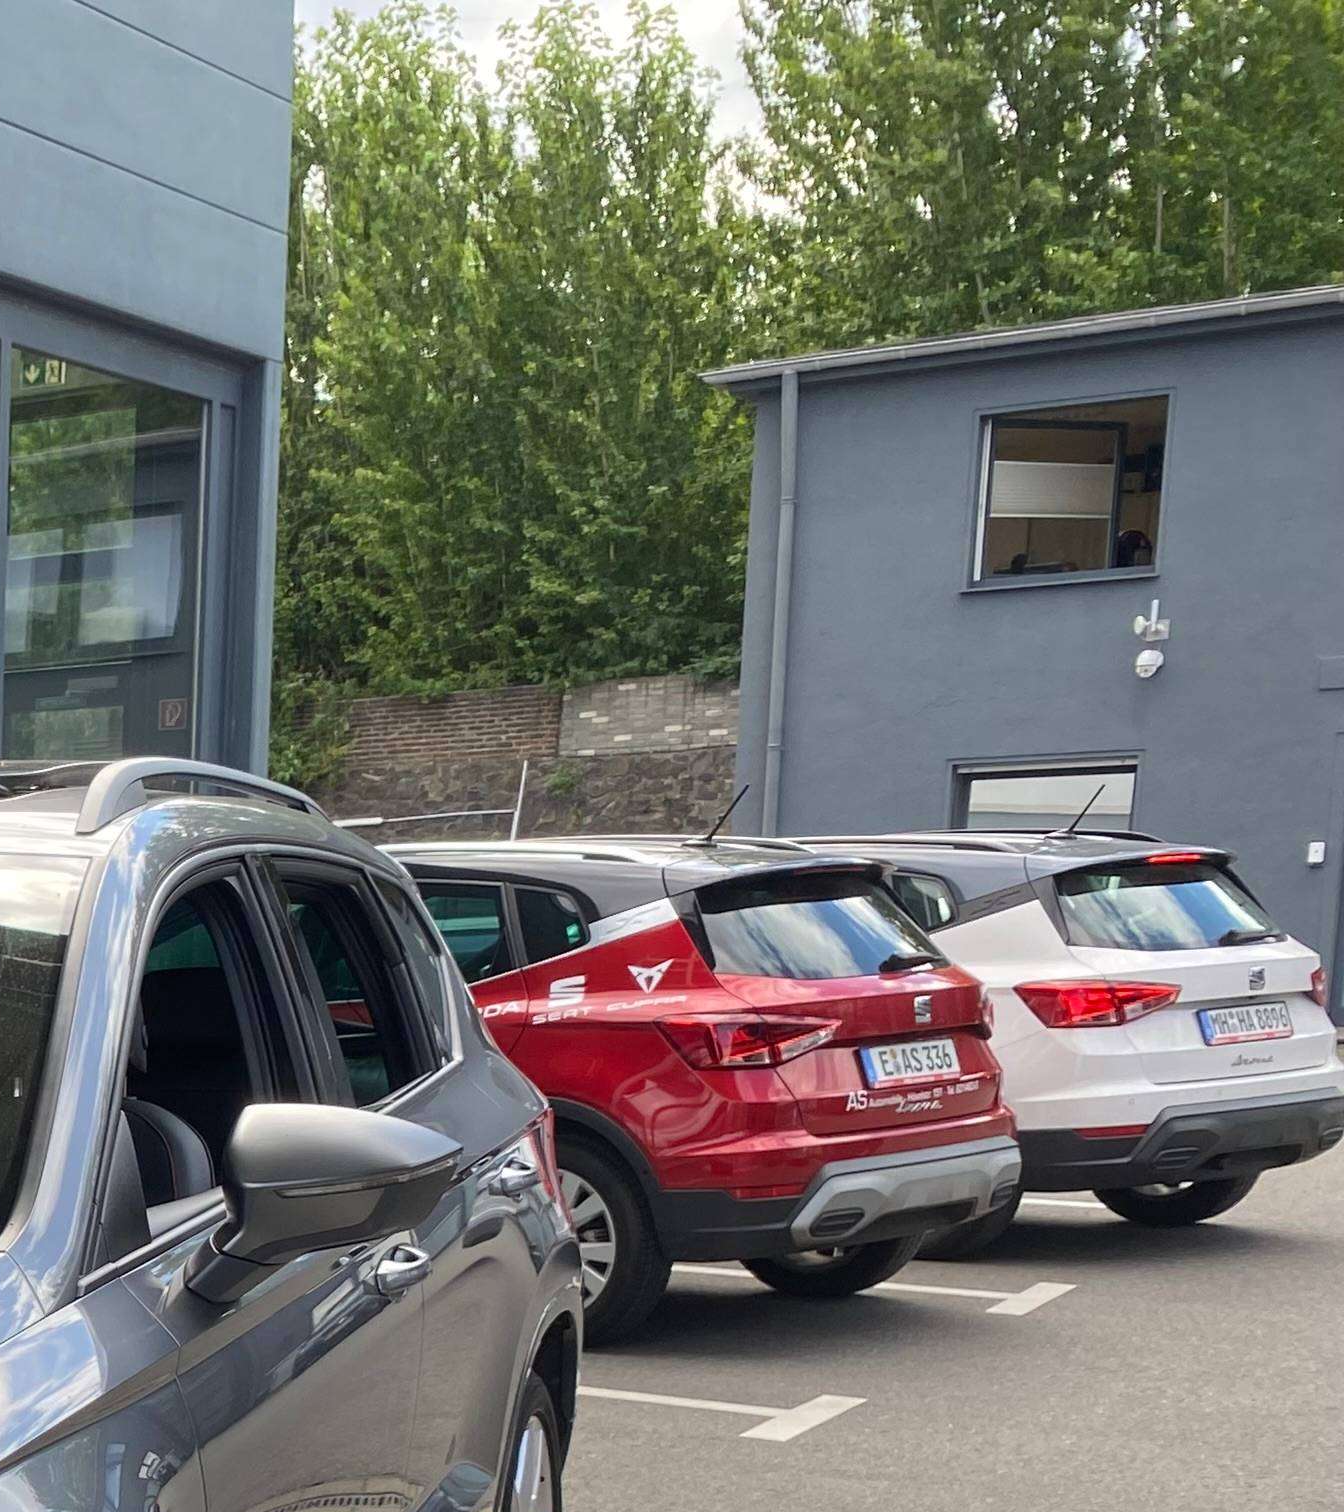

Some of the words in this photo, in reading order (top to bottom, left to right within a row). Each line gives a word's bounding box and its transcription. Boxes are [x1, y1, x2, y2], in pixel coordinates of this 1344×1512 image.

[532, 1007, 593, 1025] SEAT
[923, 1044, 953, 1070] 336
[846, 1090, 867, 1111] AS
